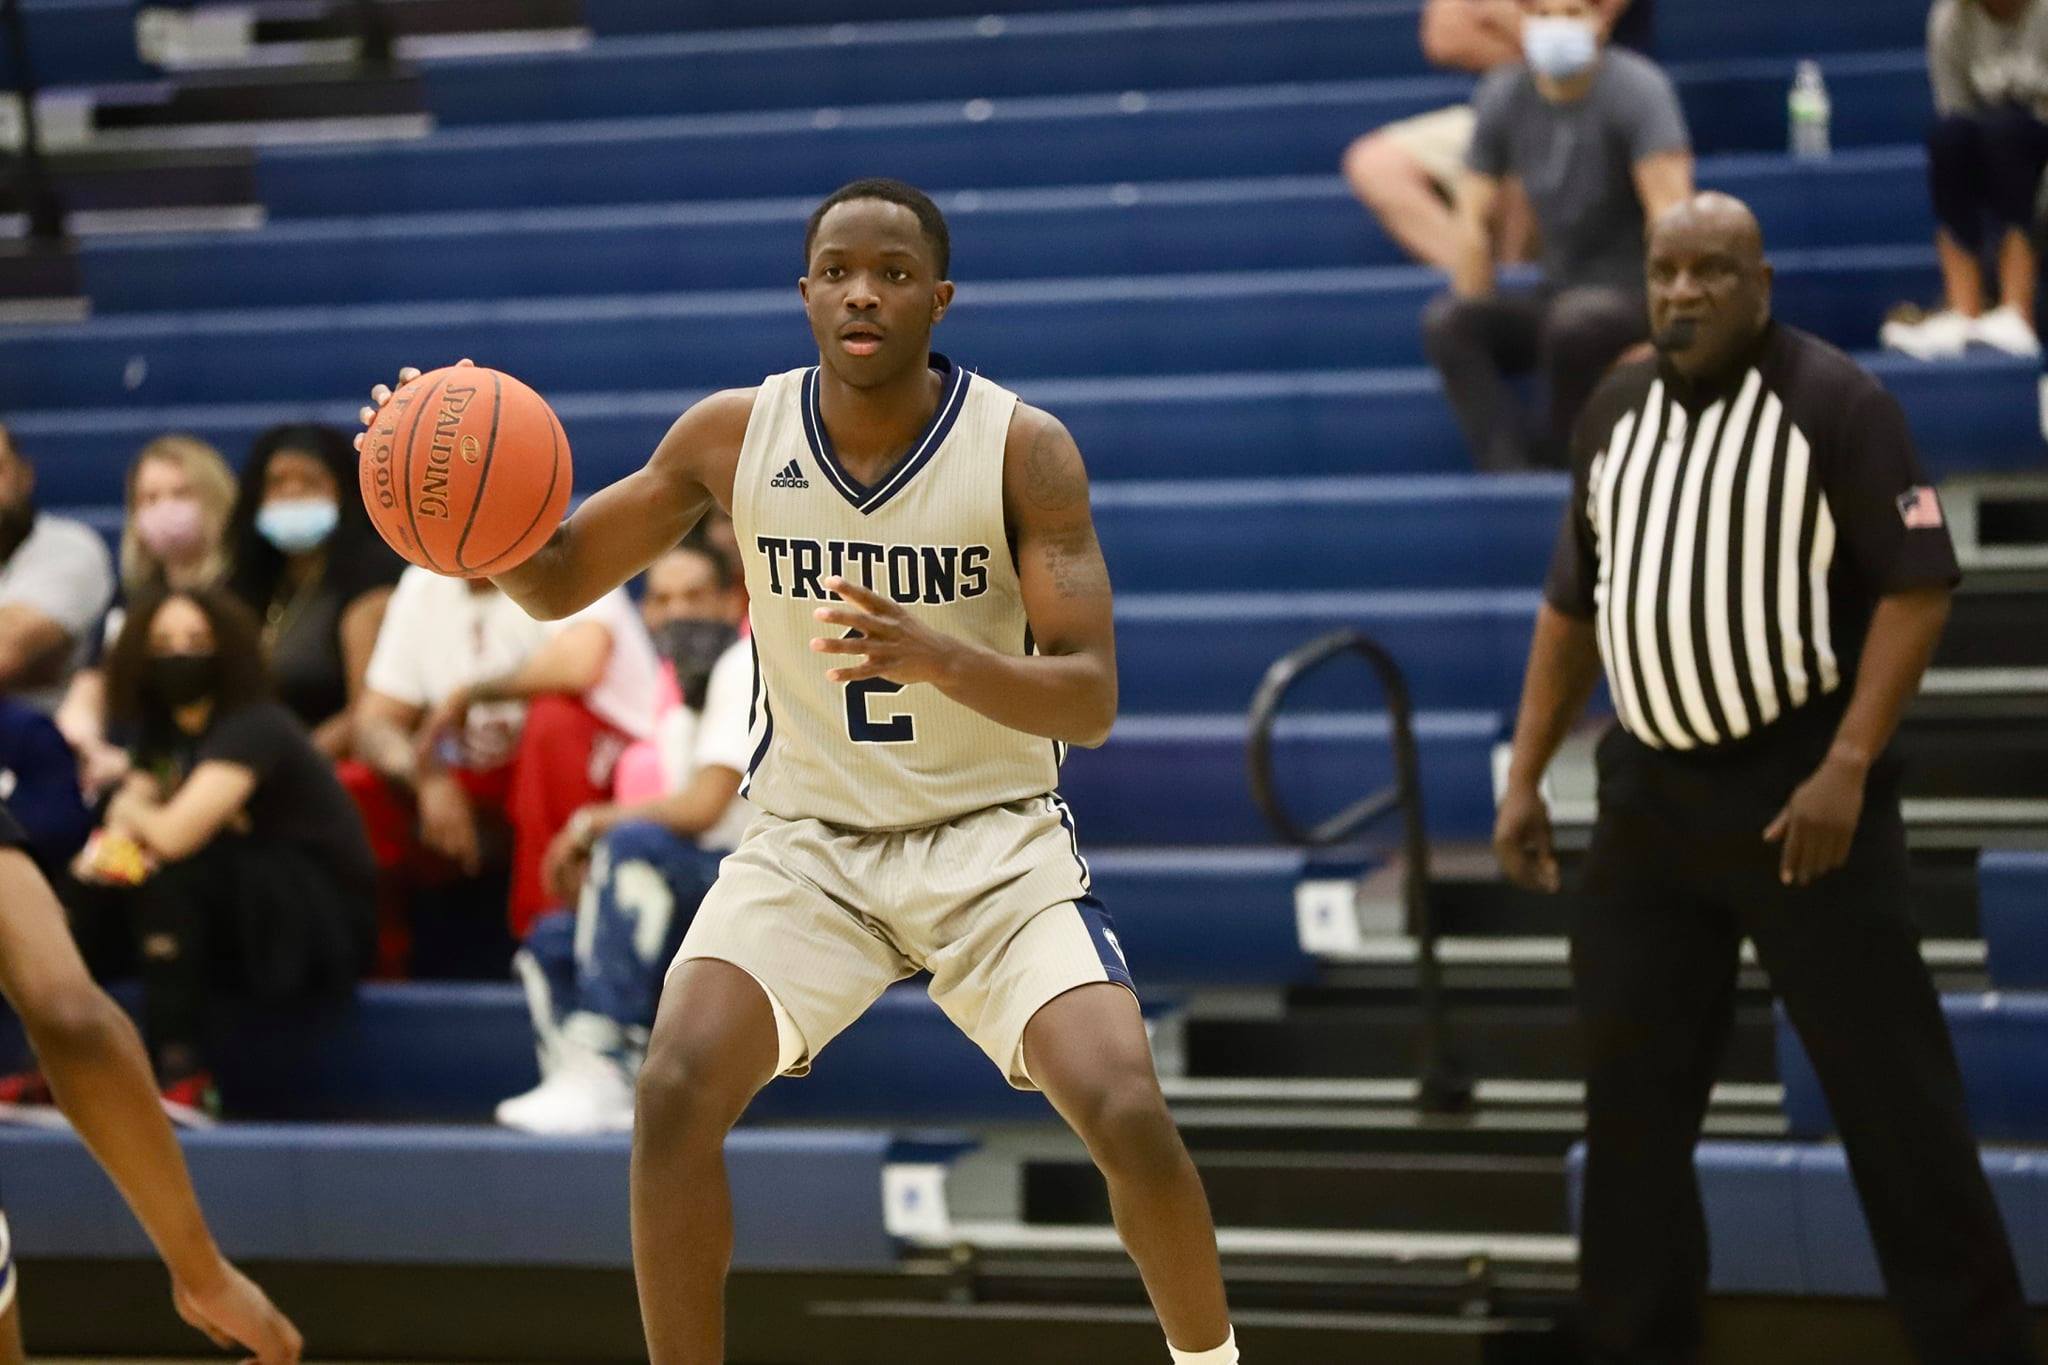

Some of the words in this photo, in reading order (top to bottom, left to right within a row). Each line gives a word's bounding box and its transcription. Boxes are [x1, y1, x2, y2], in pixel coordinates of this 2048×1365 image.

[376, 425, 394, 509] 1000
[418, 383, 477, 519] SPALDING
[770, 477, 809, 489] adidas
[756, 535, 991, 606] TRITONS
